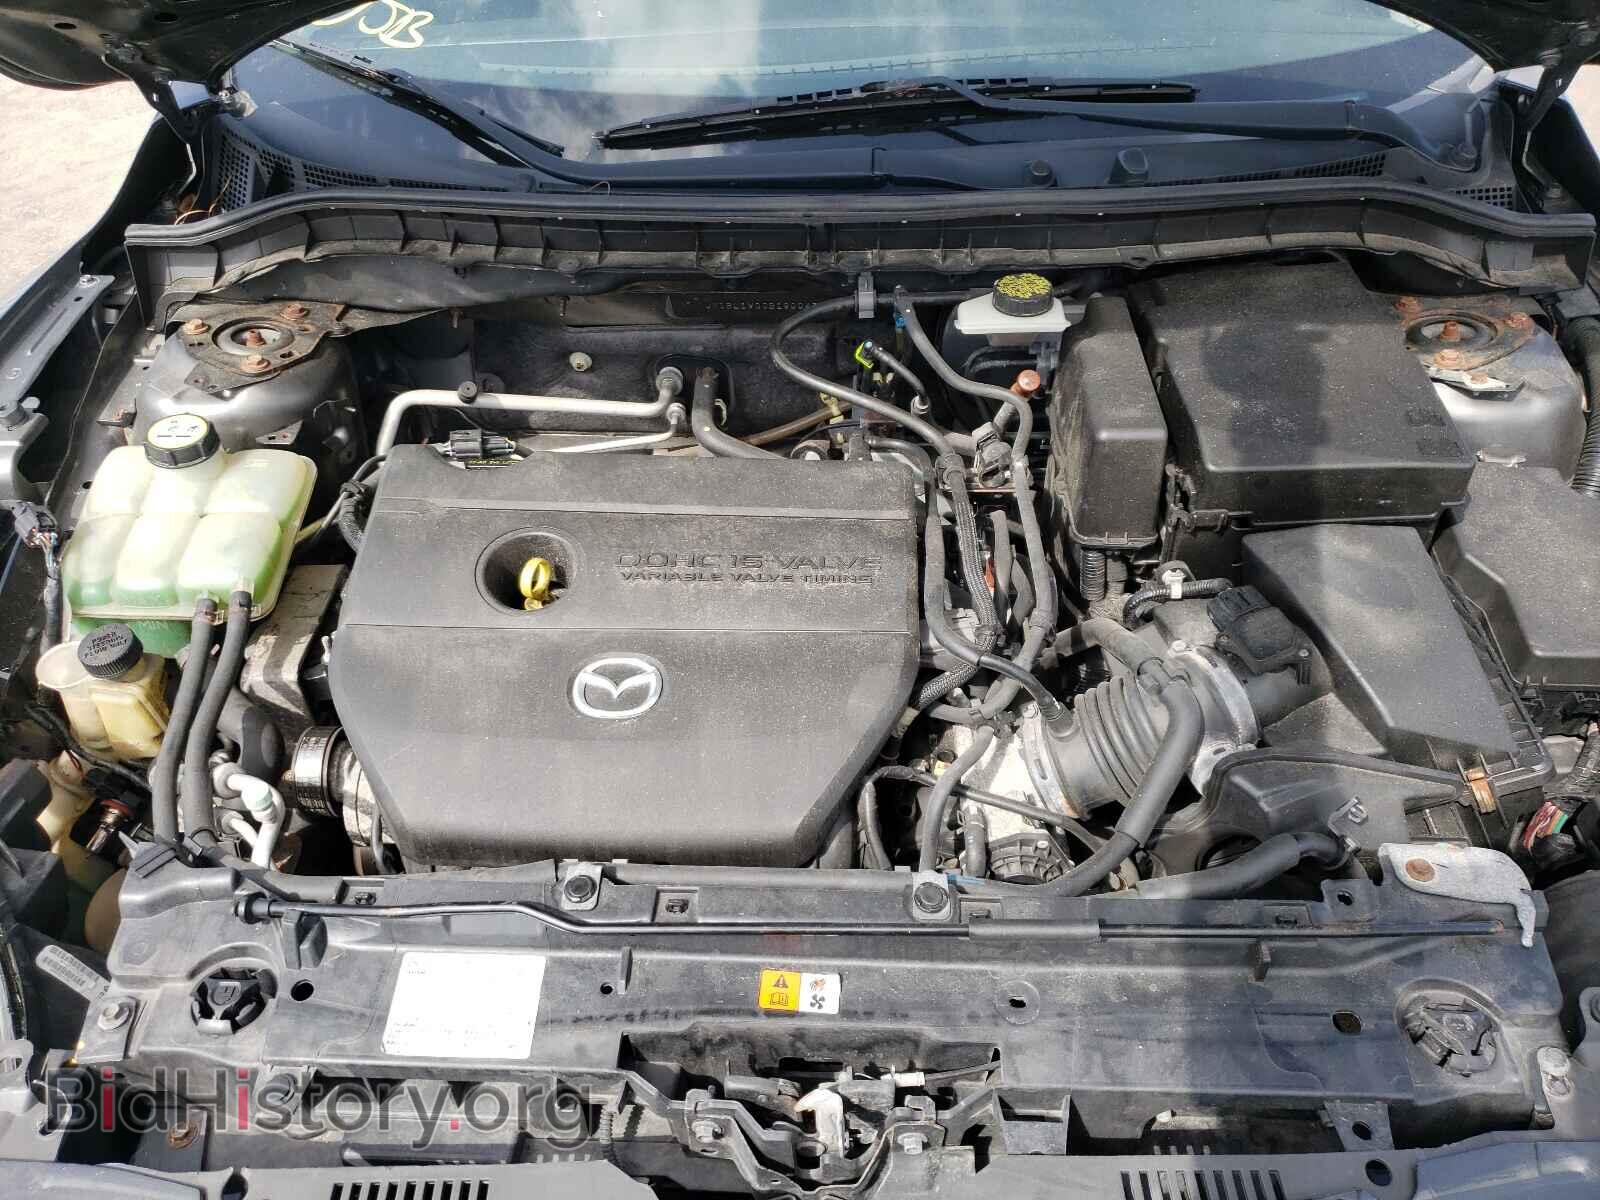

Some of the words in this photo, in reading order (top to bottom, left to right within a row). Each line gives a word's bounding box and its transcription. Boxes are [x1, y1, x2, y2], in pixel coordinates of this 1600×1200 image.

[616, 552, 721, 568] DOHC
[772, 554, 882, 571] VALVE
[620, 571, 724, 582] VARIABLE
[730, 573, 794, 583] VALVE
[803, 574, 873, 584] TIMING
